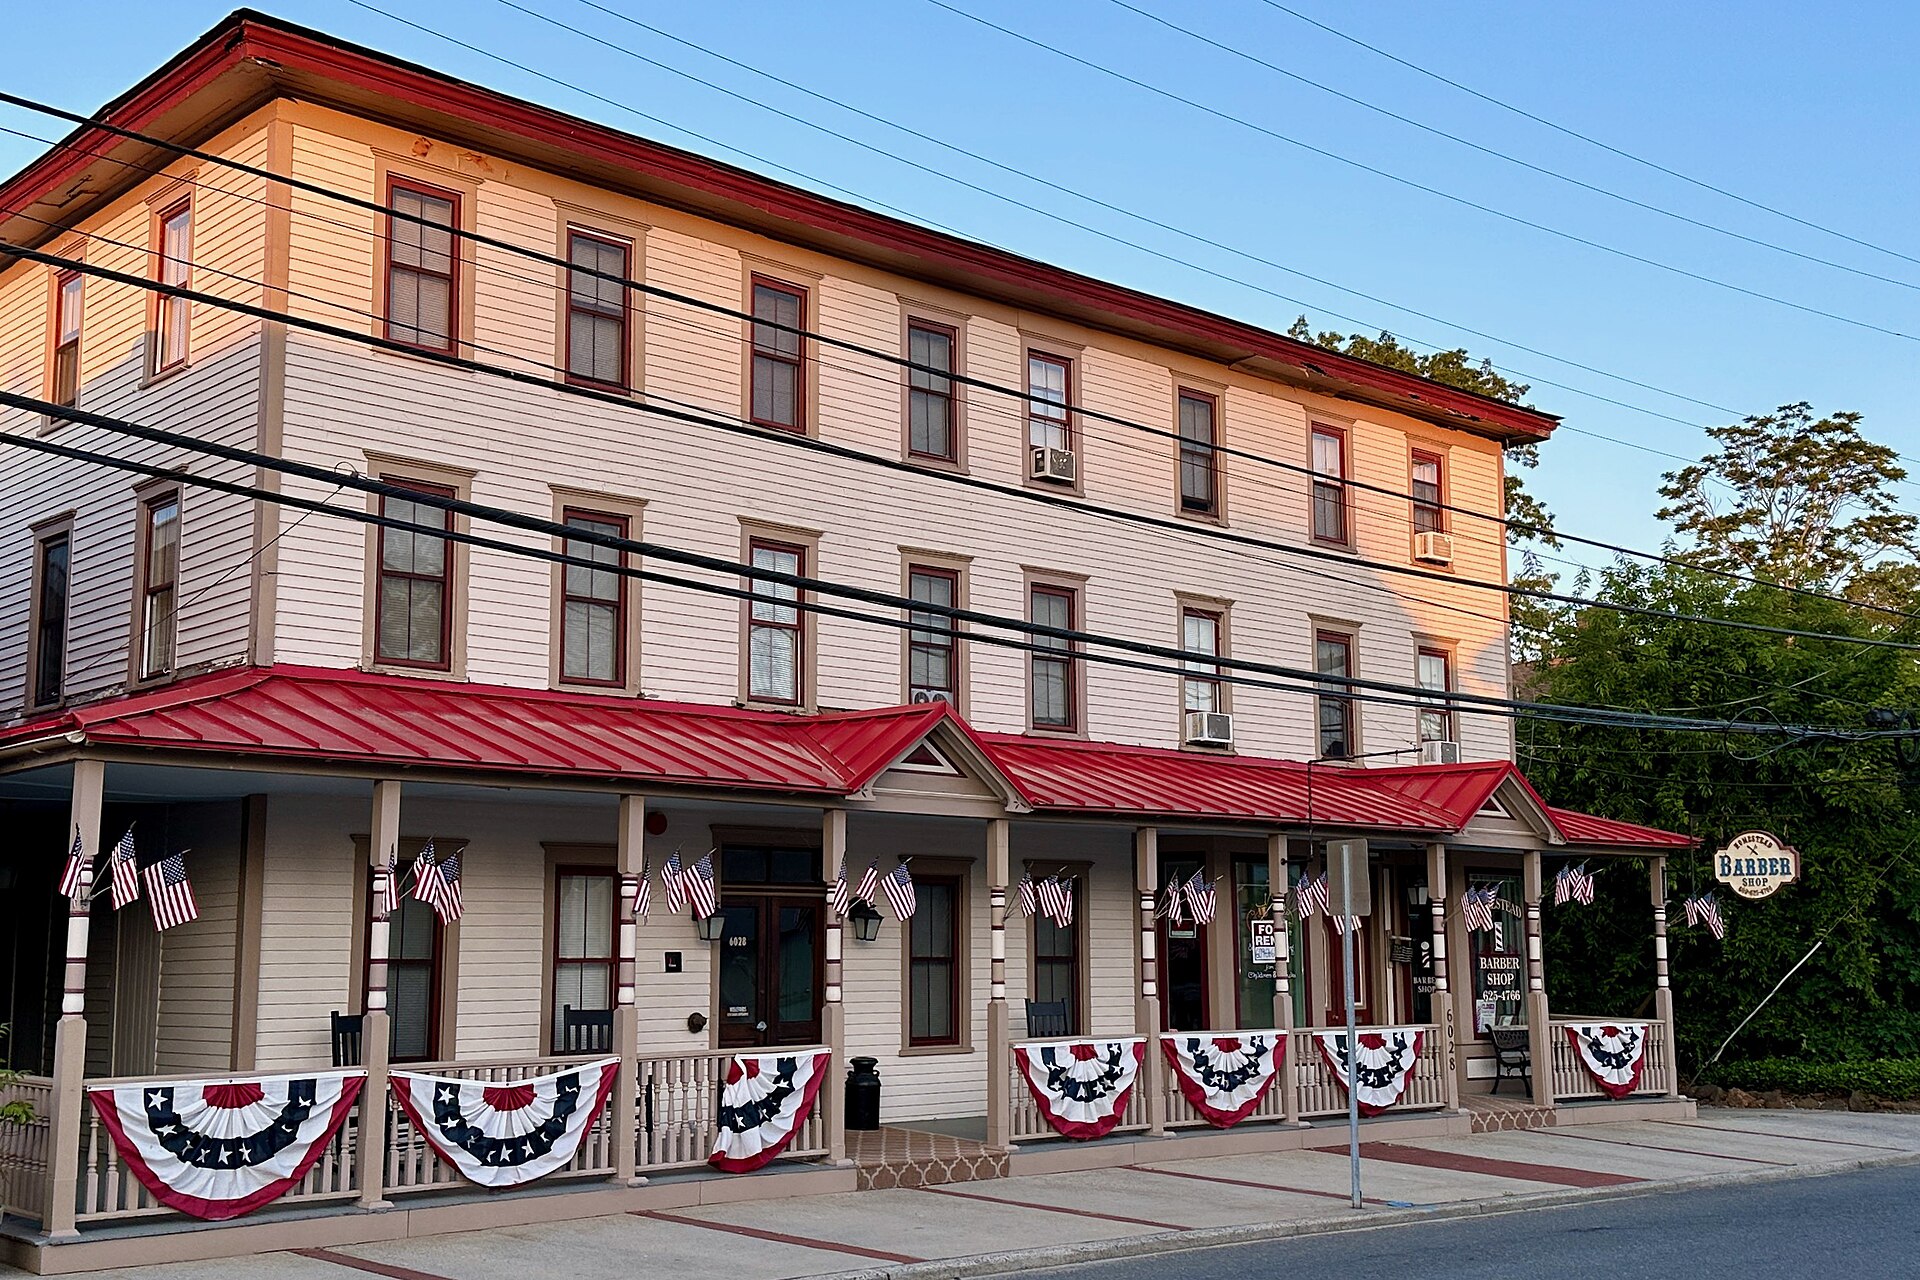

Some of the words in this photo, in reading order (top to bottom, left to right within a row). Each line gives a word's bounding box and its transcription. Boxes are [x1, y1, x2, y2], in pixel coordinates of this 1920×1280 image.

[1733, 835, 1773, 850] HOMESTEAD
[1719, 855, 1792, 876] BARBER
[1742, 877, 1768, 887] SHOP
[1258, 924, 1274, 935] FO
[729, 936, 747, 946] 6028
[1255, 936, 1275, 946] REN
[1480, 957, 1520, 970] BARBER
[1413, 976, 1436, 985] BARBE
[1487, 973, 1514, 986] SHOP
[1482, 990, 1520, 1002] 625-4766
[1446, 1008, 1456, 1071] 6028
